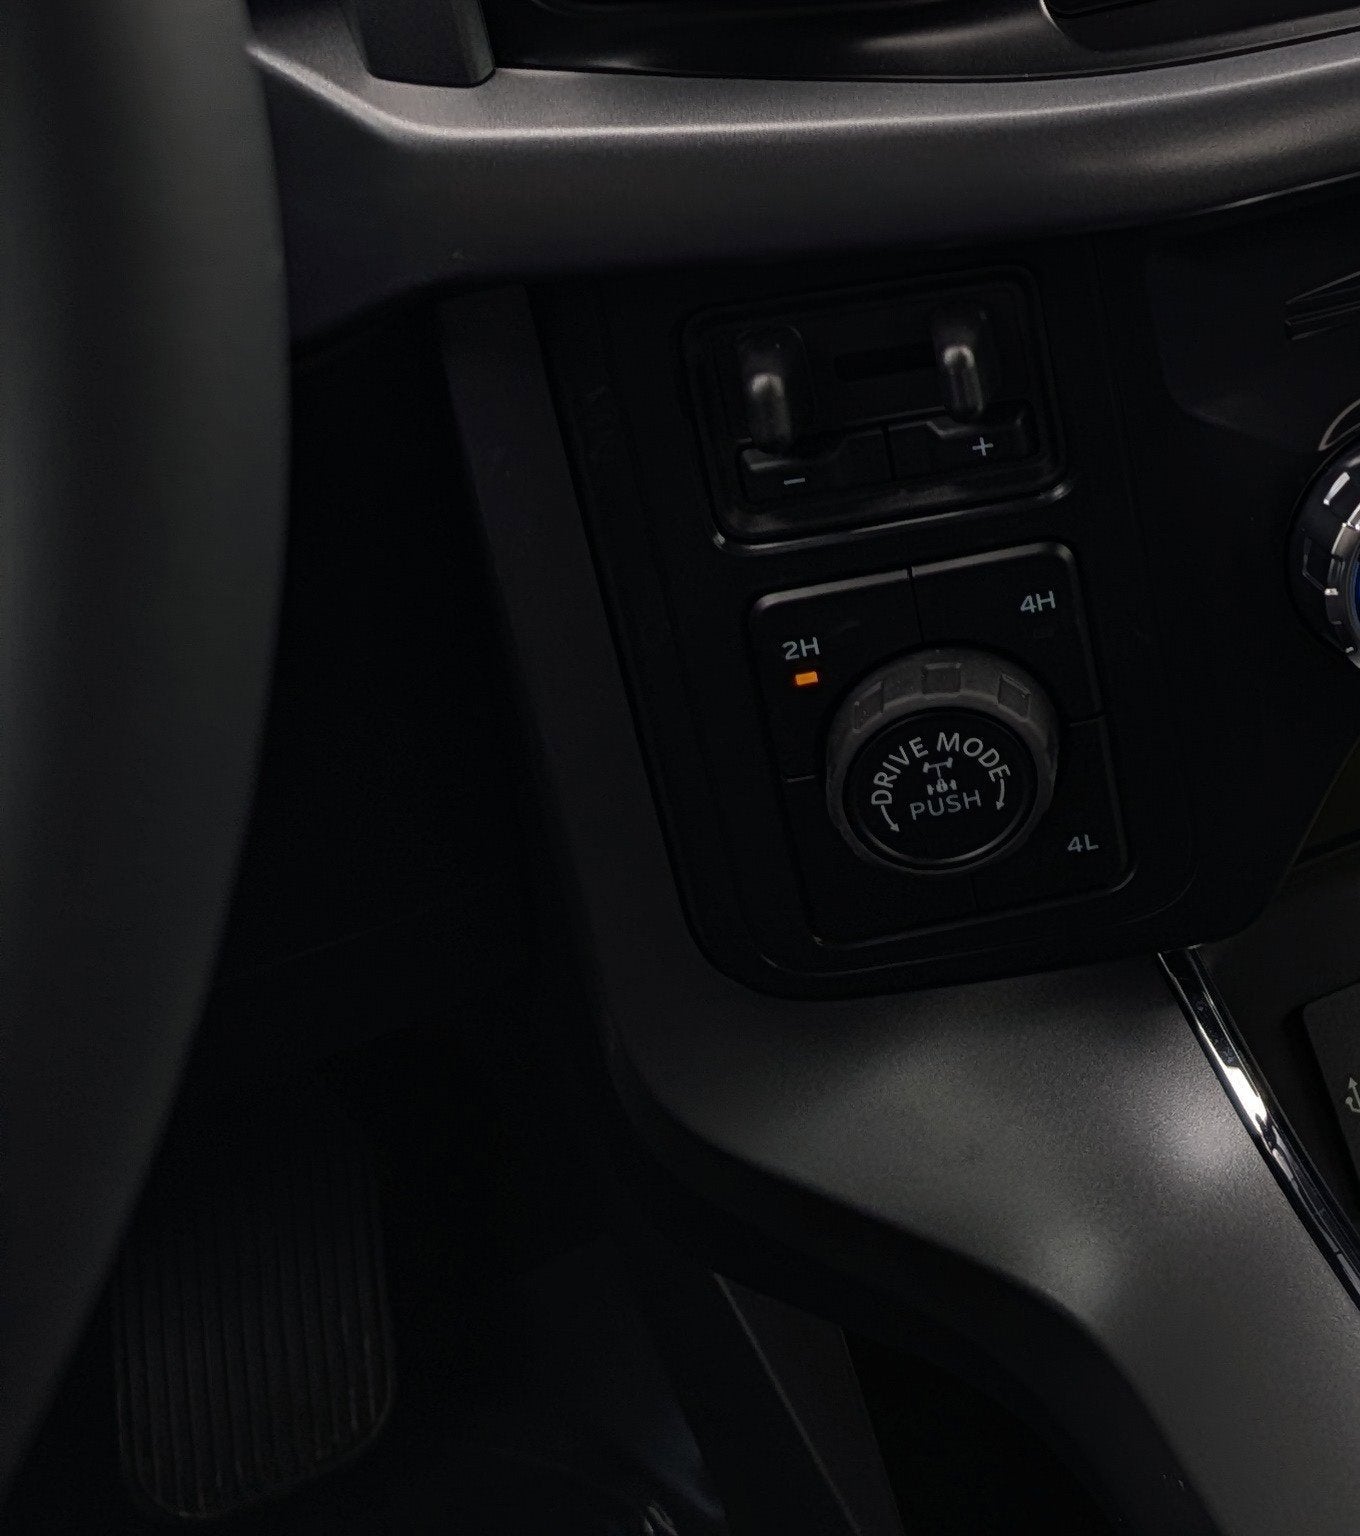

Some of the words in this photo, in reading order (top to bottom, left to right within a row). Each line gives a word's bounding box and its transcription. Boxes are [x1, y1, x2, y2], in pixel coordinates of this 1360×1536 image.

[1020, 590, 1057, 615] 4H
[781, 636, 820, 661] 2H
[871, 736, 929, 805] DRIVE
[936, 731, 1011, 783] MODE
[909, 788, 982, 821] PUSH
[1067, 834, 1099, 853] 4L
